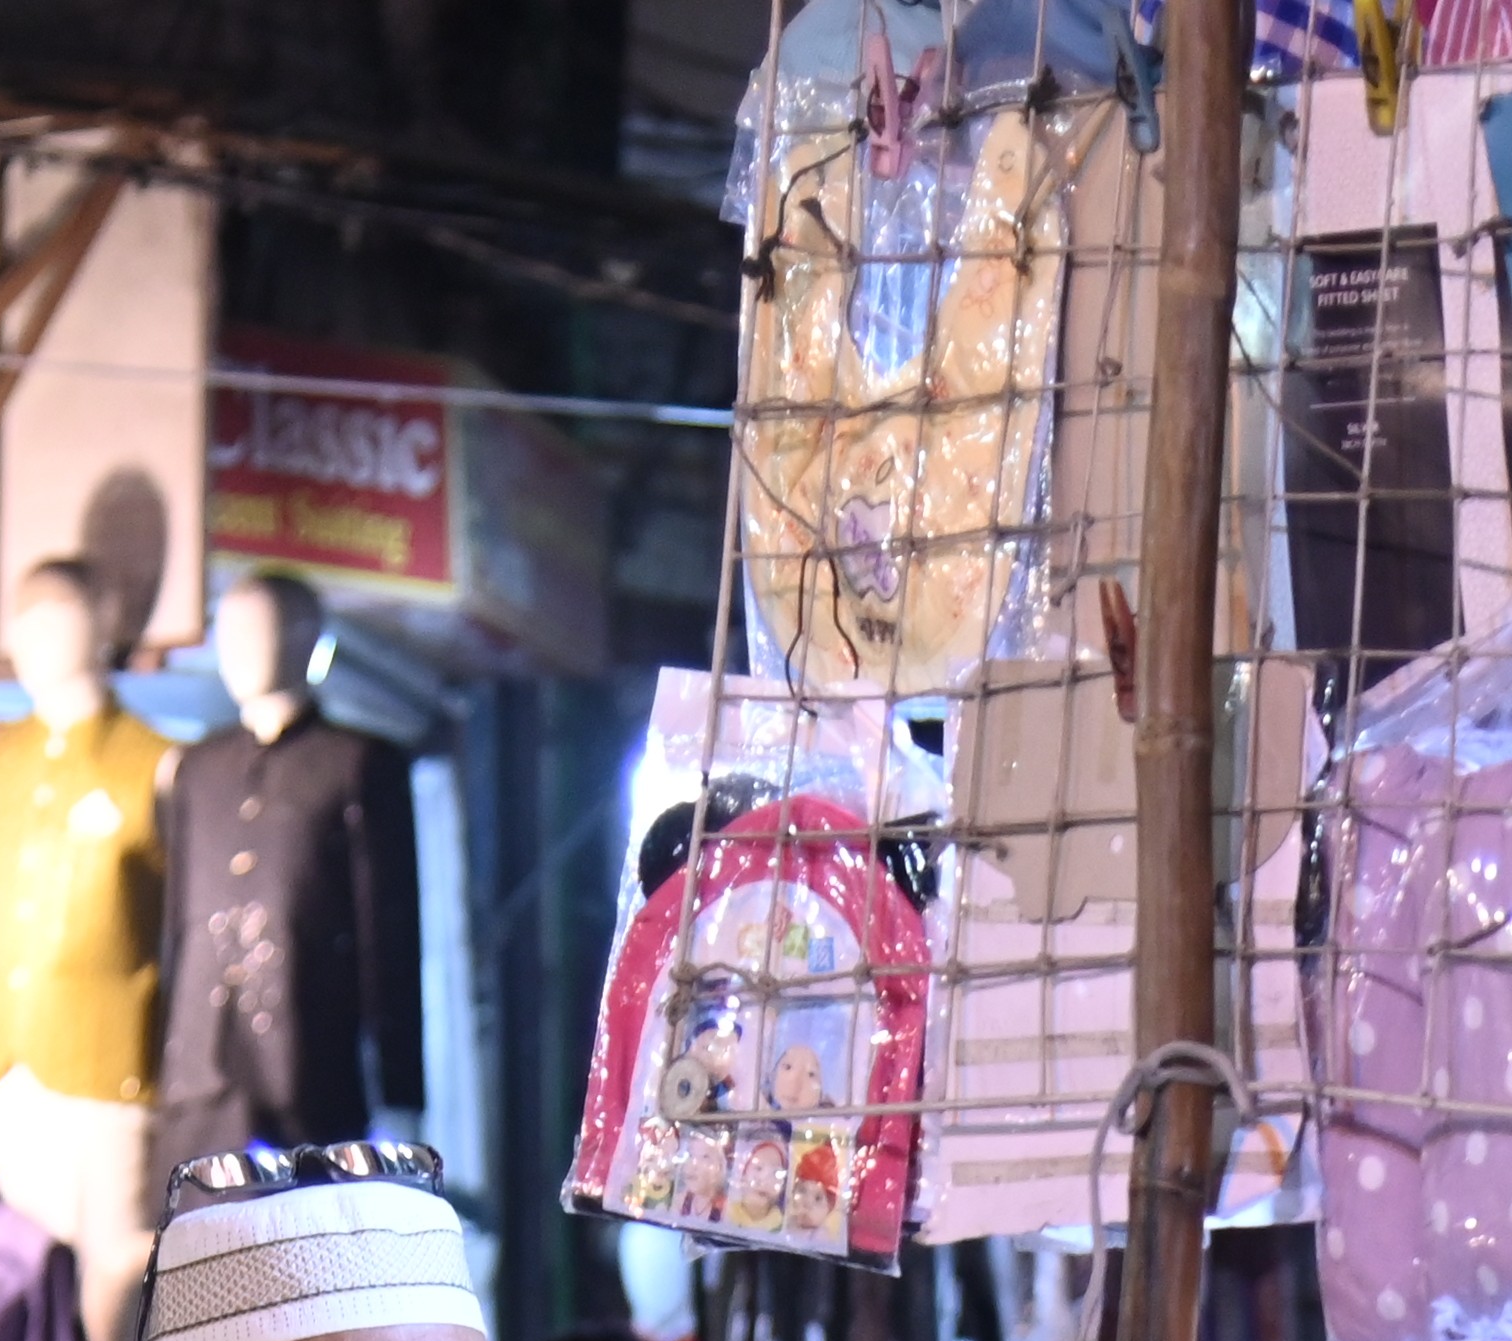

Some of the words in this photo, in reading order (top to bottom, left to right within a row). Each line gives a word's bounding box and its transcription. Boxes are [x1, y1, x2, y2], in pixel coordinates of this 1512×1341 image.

[1309, 272, 1337, 289] SOFT
[1339, 271, 1348, 287] &
[1317, 289, 1359, 307] FITTED
[1361, 286, 1400, 304] SHET
